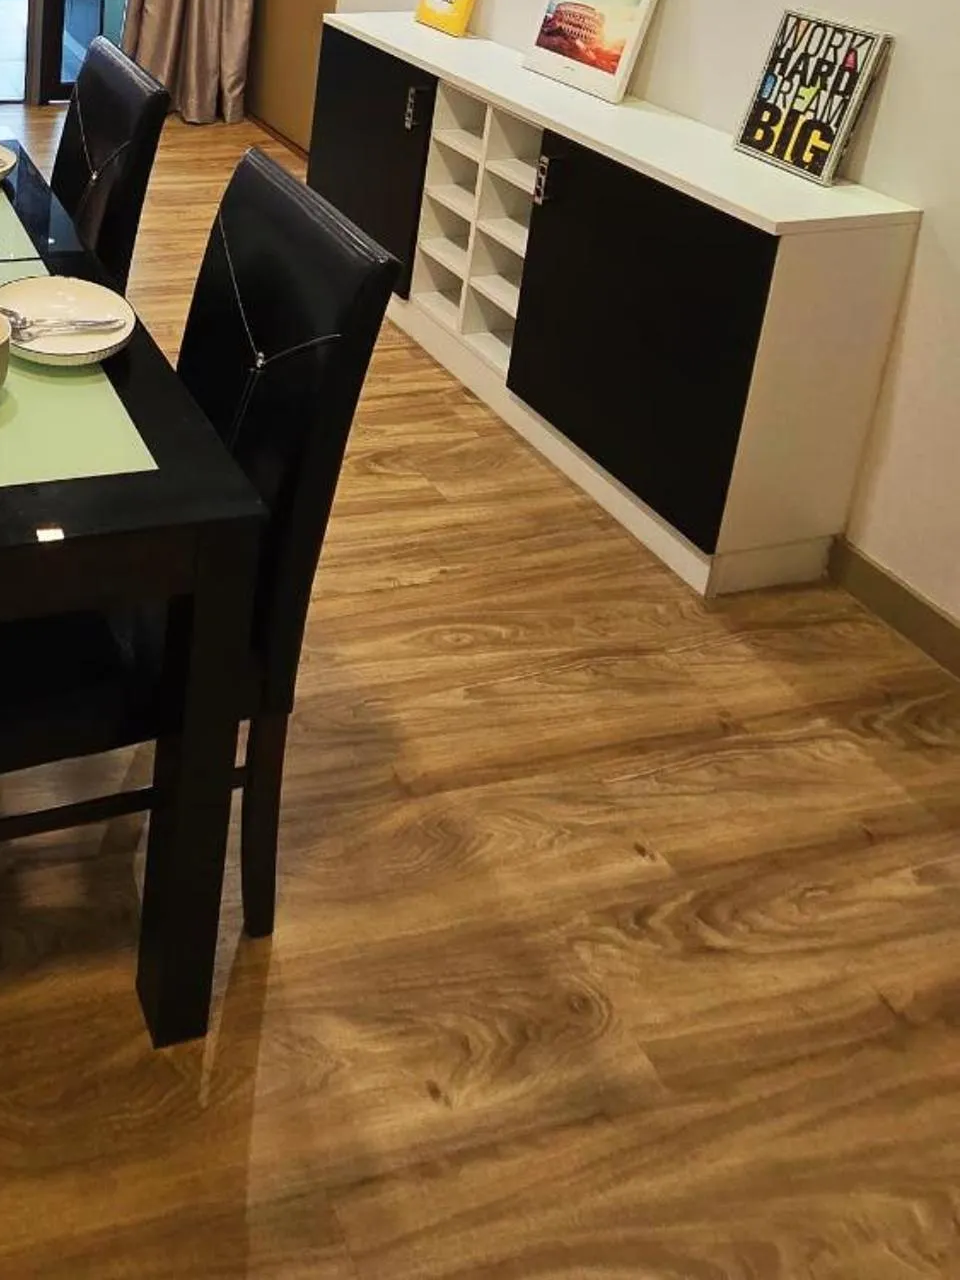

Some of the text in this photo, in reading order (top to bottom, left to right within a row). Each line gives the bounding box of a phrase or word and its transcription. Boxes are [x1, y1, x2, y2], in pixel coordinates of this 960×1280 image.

[777, 14, 874, 69] WORK
[767, 47, 859, 97] HARD
[757, 72, 851, 128] DREAM
[741, 100, 836, 176] BIG
